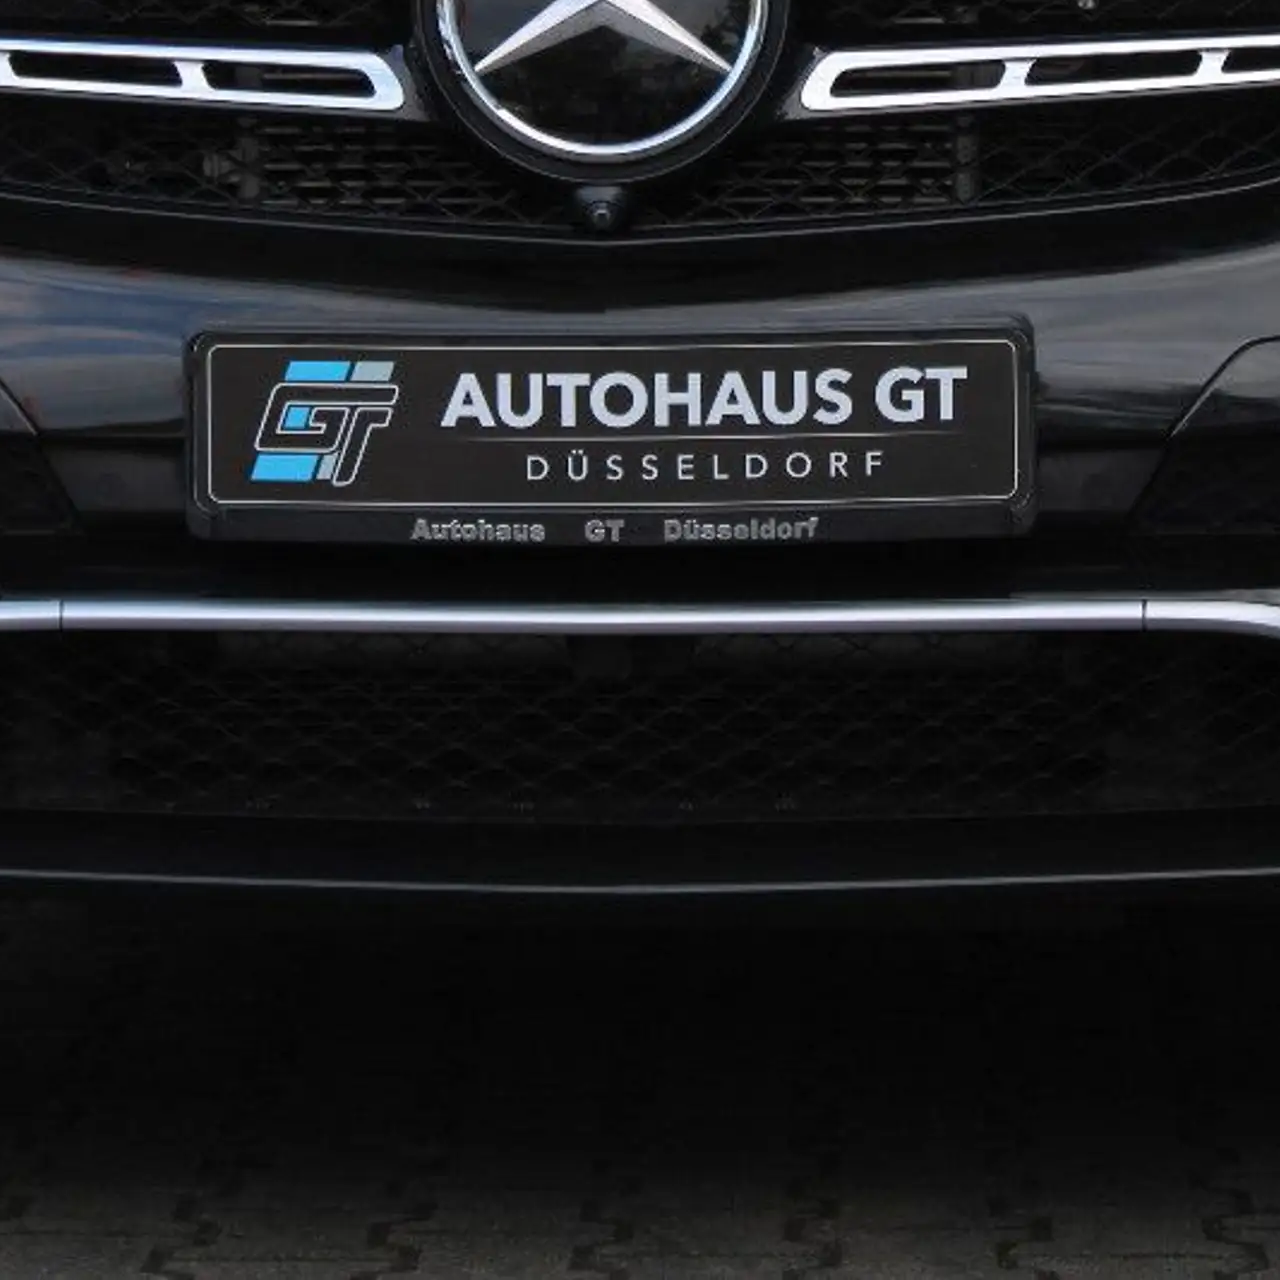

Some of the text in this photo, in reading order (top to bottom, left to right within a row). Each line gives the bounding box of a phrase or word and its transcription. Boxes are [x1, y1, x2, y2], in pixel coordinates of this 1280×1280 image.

[440, 365, 968, 429] AUTOHAUS GT
[527, 450, 883, 481] DÜSSELDORF
[410, 516, 819, 542] Autohaus GT Düsseldorf
